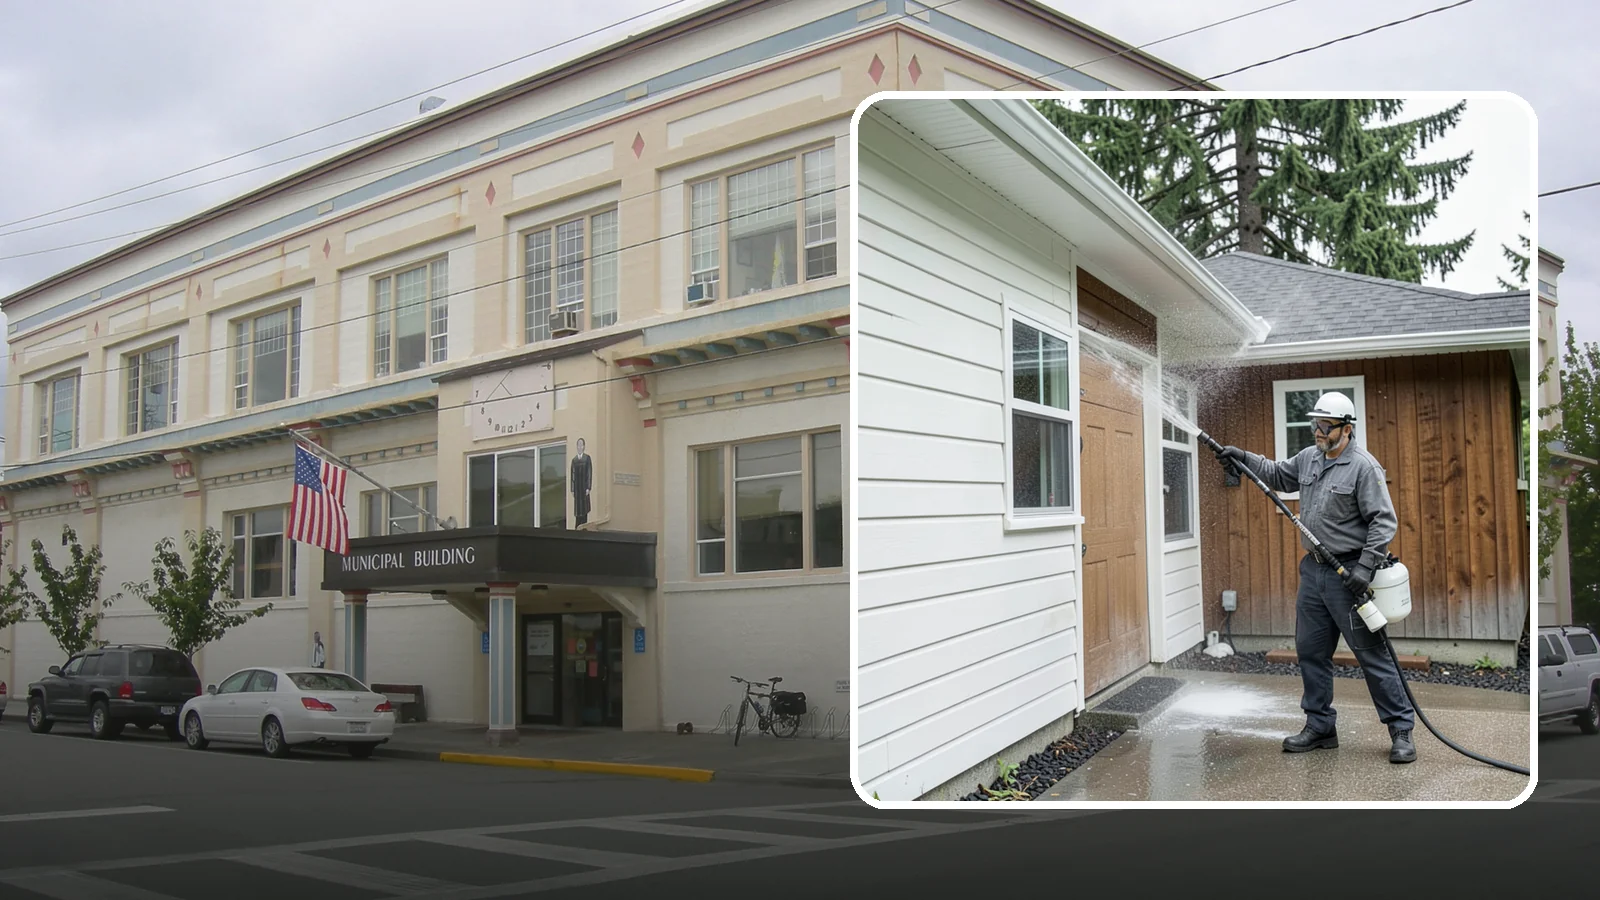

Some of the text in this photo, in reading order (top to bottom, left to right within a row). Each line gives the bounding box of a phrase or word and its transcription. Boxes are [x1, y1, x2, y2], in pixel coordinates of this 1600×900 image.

[487, 418, 492, 426] 9
[528, 414, 533, 422] 3
[521, 420, 526, 428] 2
[342, 546, 475, 572] MUNICIPAL BUILDING
